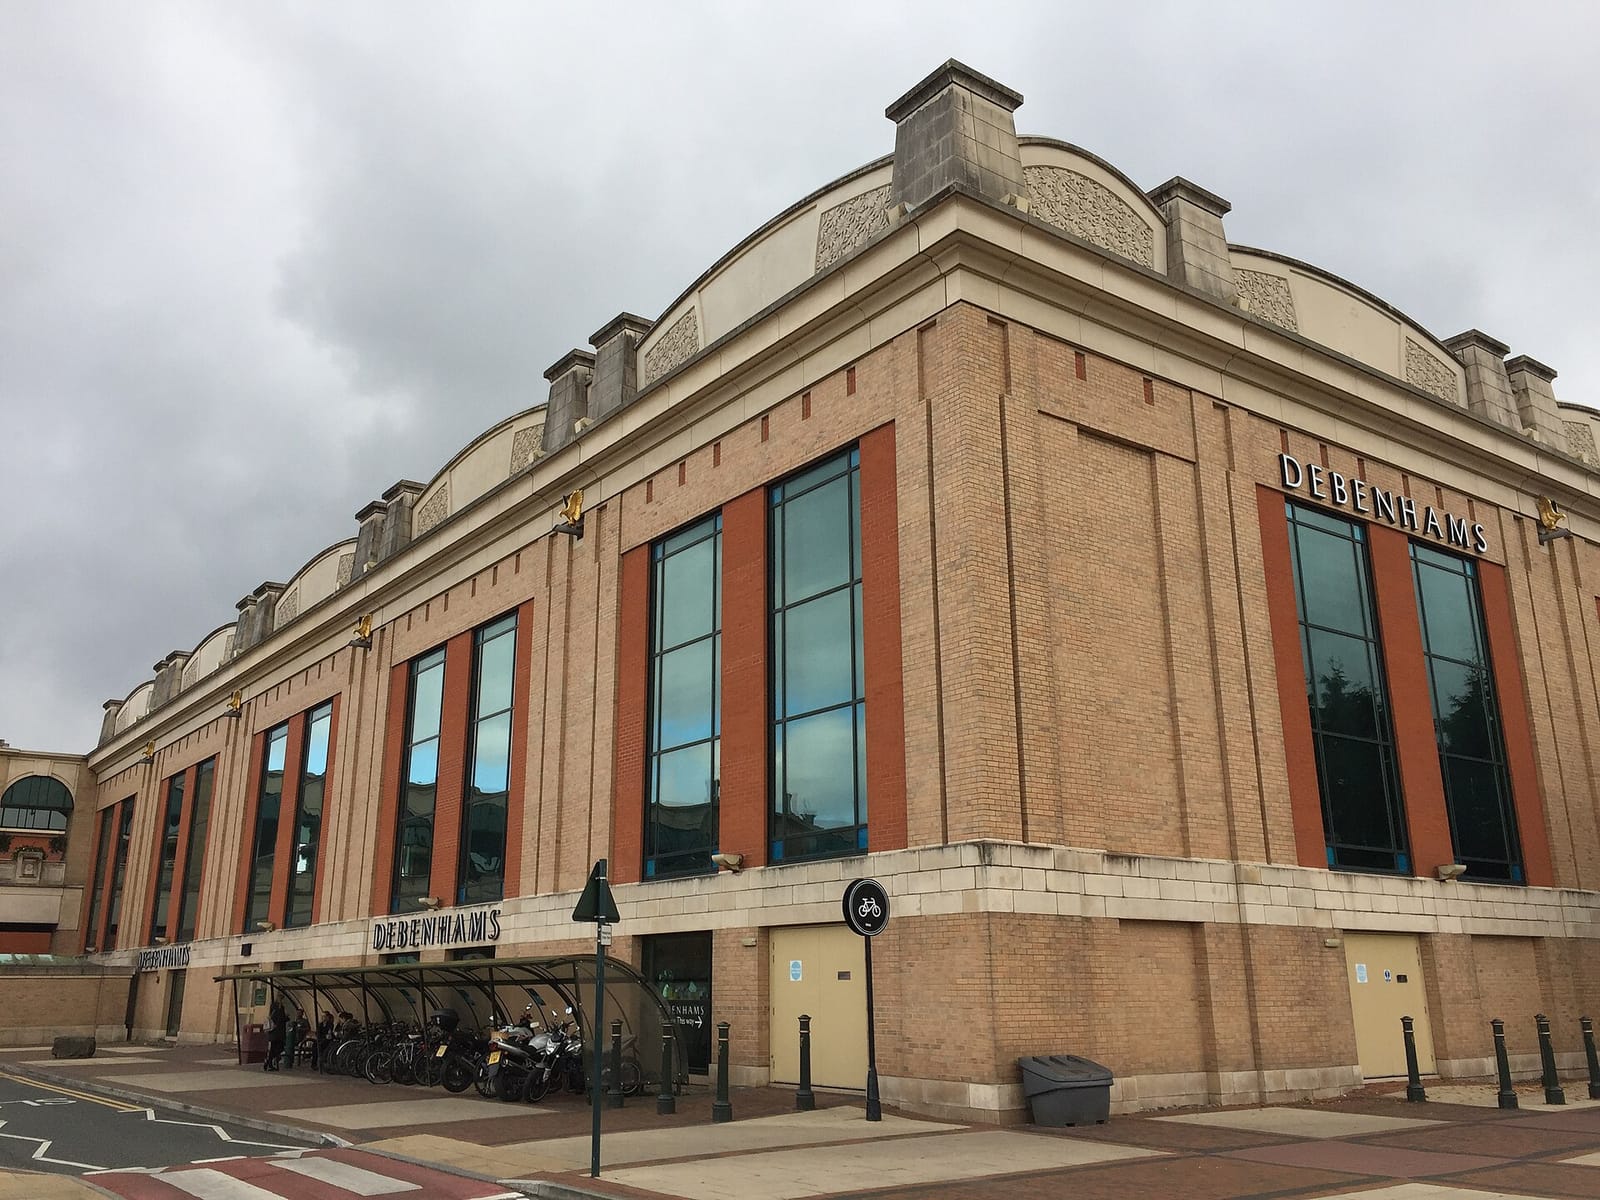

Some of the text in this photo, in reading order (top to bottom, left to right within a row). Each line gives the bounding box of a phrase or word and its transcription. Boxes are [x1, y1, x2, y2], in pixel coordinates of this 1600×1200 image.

[1279, 453, 1488, 553] DEBENHAMS
[373, 909, 501, 950] DEBENHAMS
[671, 1005, 704, 1015] ENHAMS
